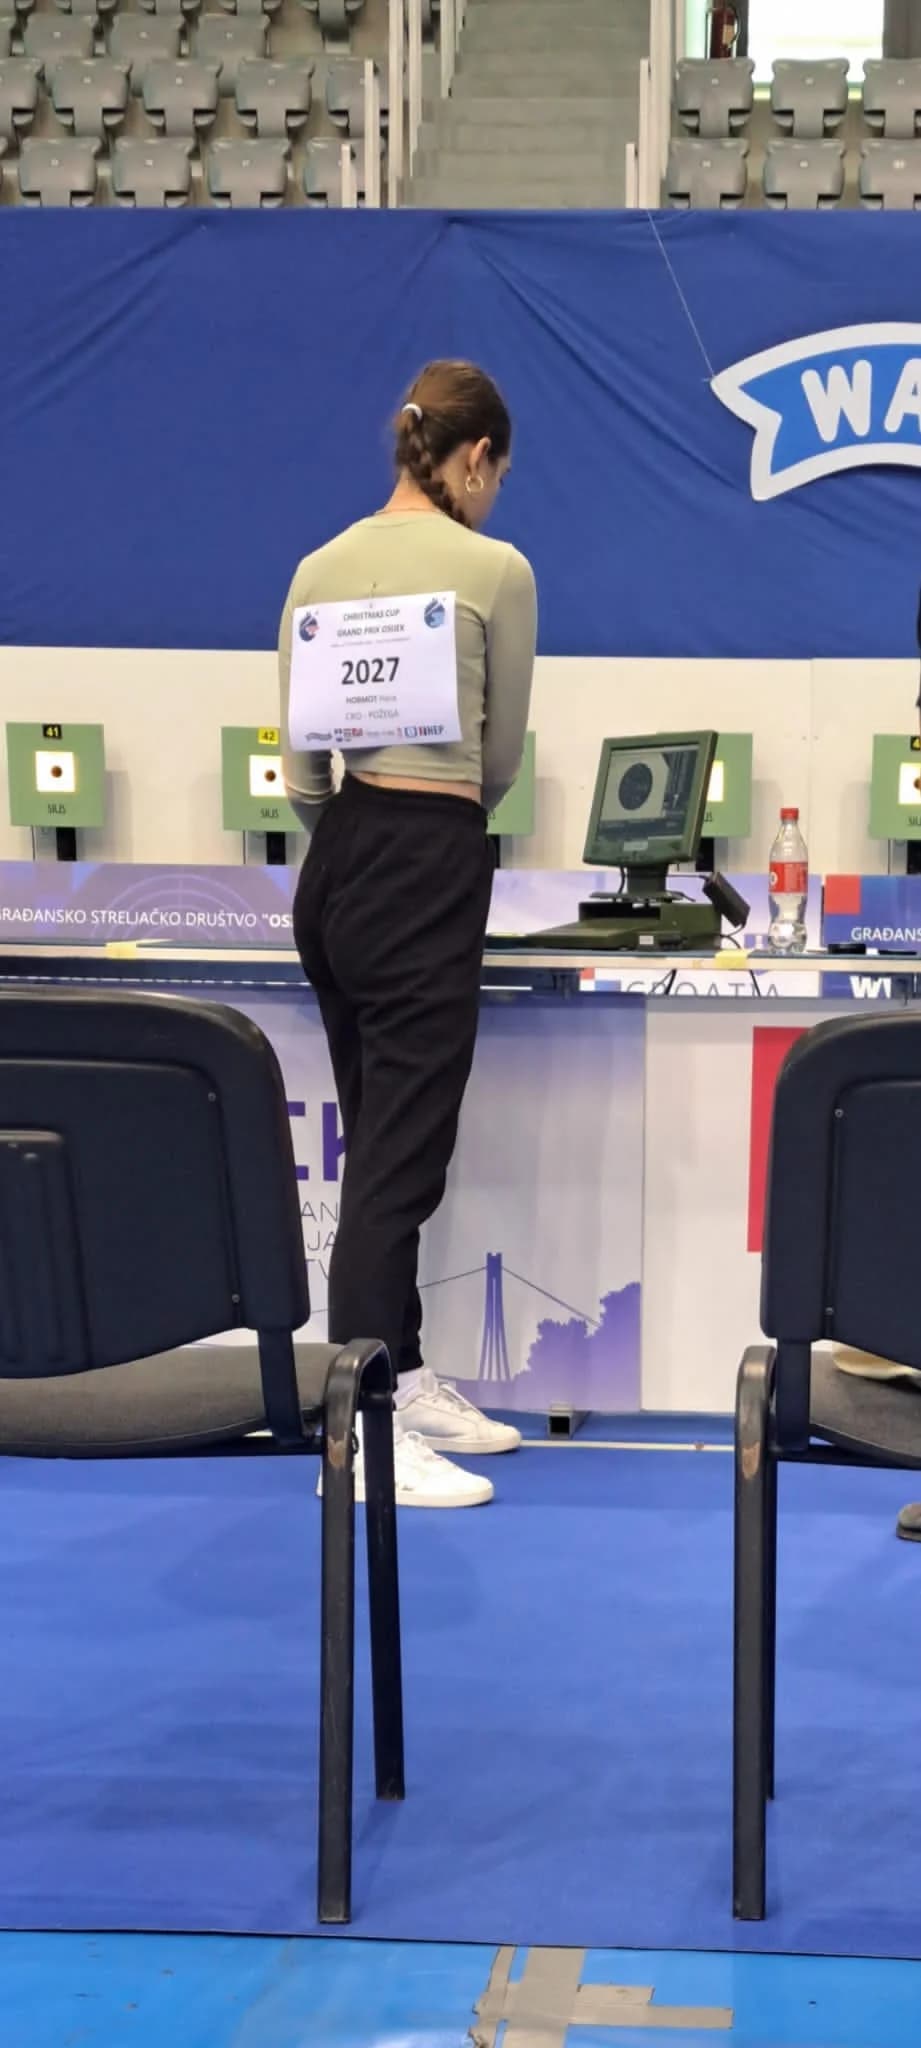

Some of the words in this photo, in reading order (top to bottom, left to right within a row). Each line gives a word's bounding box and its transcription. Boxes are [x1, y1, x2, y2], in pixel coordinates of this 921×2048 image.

[343, 611, 384, 621] CHRISTMAS
[385, 608, 400, 617] CUP
[336, 627, 362, 638] GRAND
[364, 626, 380, 635] PRIX
[341, 656, 400, 685] 2027
[46, 726, 59, 737] 41
[263, 731, 276, 741] 42
[0, 907, 87, 924] RAĐANSKO
[91, 907, 181, 926] STRELJAČKO
[185, 909, 257, 927] DRUŠTVO
